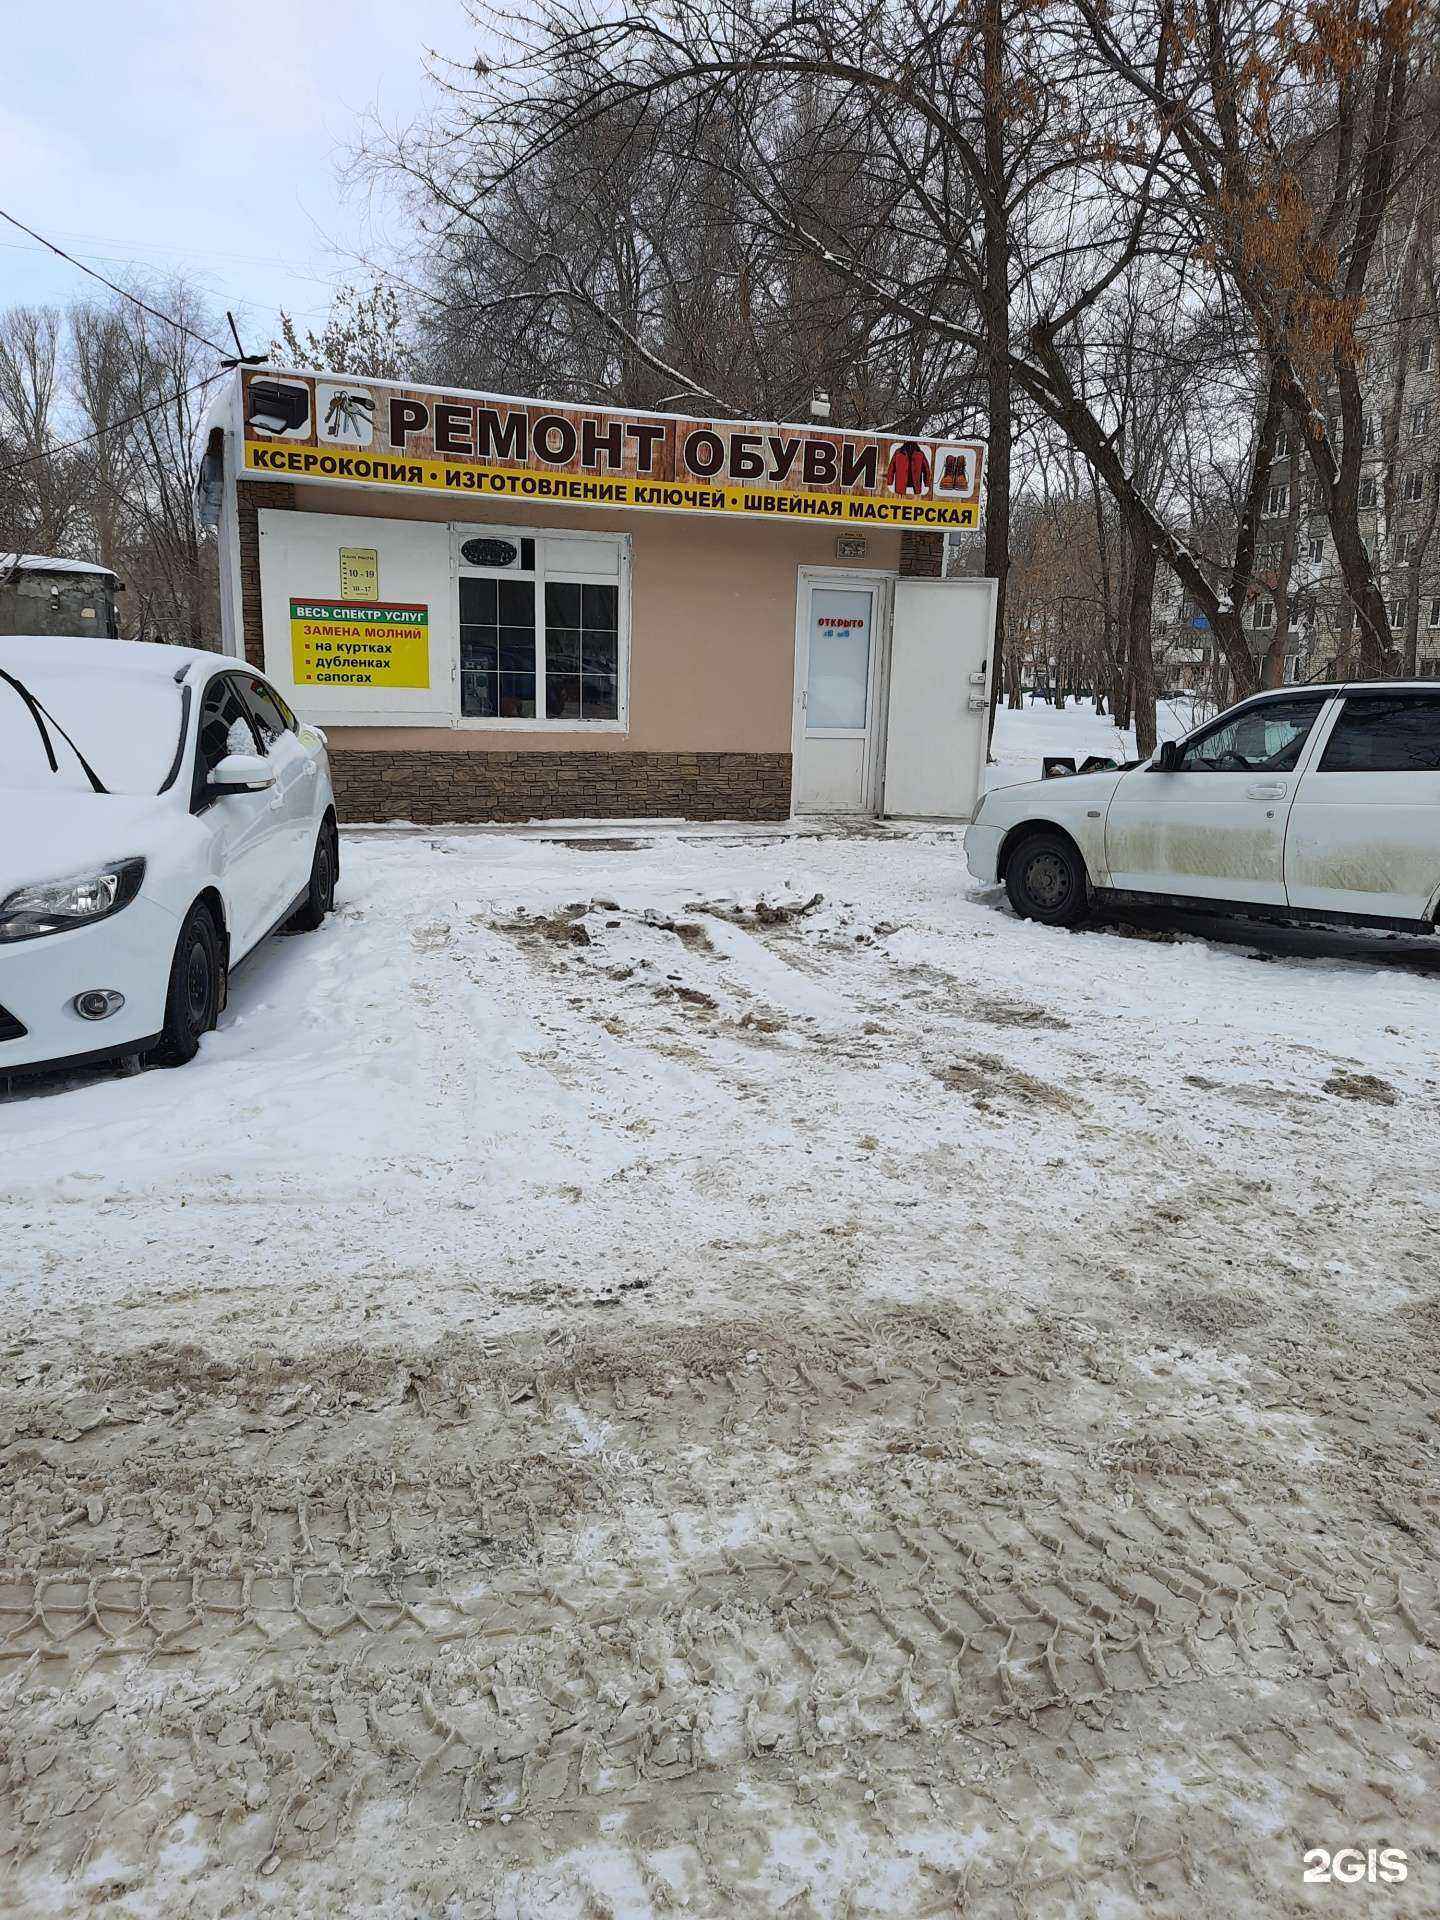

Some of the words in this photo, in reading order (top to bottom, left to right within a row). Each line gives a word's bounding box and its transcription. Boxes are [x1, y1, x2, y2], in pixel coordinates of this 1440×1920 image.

[388, 397, 666, 472] РЕМОНТ
[683, 428, 878, 489] ОБУВИ
[253, 449, 423, 483] КСЕРОКОПИЯ
[445, 469, 627, 501] ИЗГОТОВЛЕНИЕ
[634, 486, 725, 508] КЛЮЧЕЙ
[744, 493, 843, 516] ШВЕЙНАЯ
[849, 502, 973, 525] МАСТЕРСКАЯ
[296, 607, 329, 618] ВЕСЬ
[332, 607, 381, 619] СПЕКТР
[384, 610, 424, 622] УСЛУГ
[818, 617, 864, 628] ОТКРЫТО
[303, 625, 360, 637] ЗАМЕНА
[365, 627, 422, 640] МОЛНИЙ
[315, 642, 332, 652] на
[337, 643, 392, 655] куртках
[315, 656, 391, 668] дубленках
[316, 673, 372, 683] сапогах
